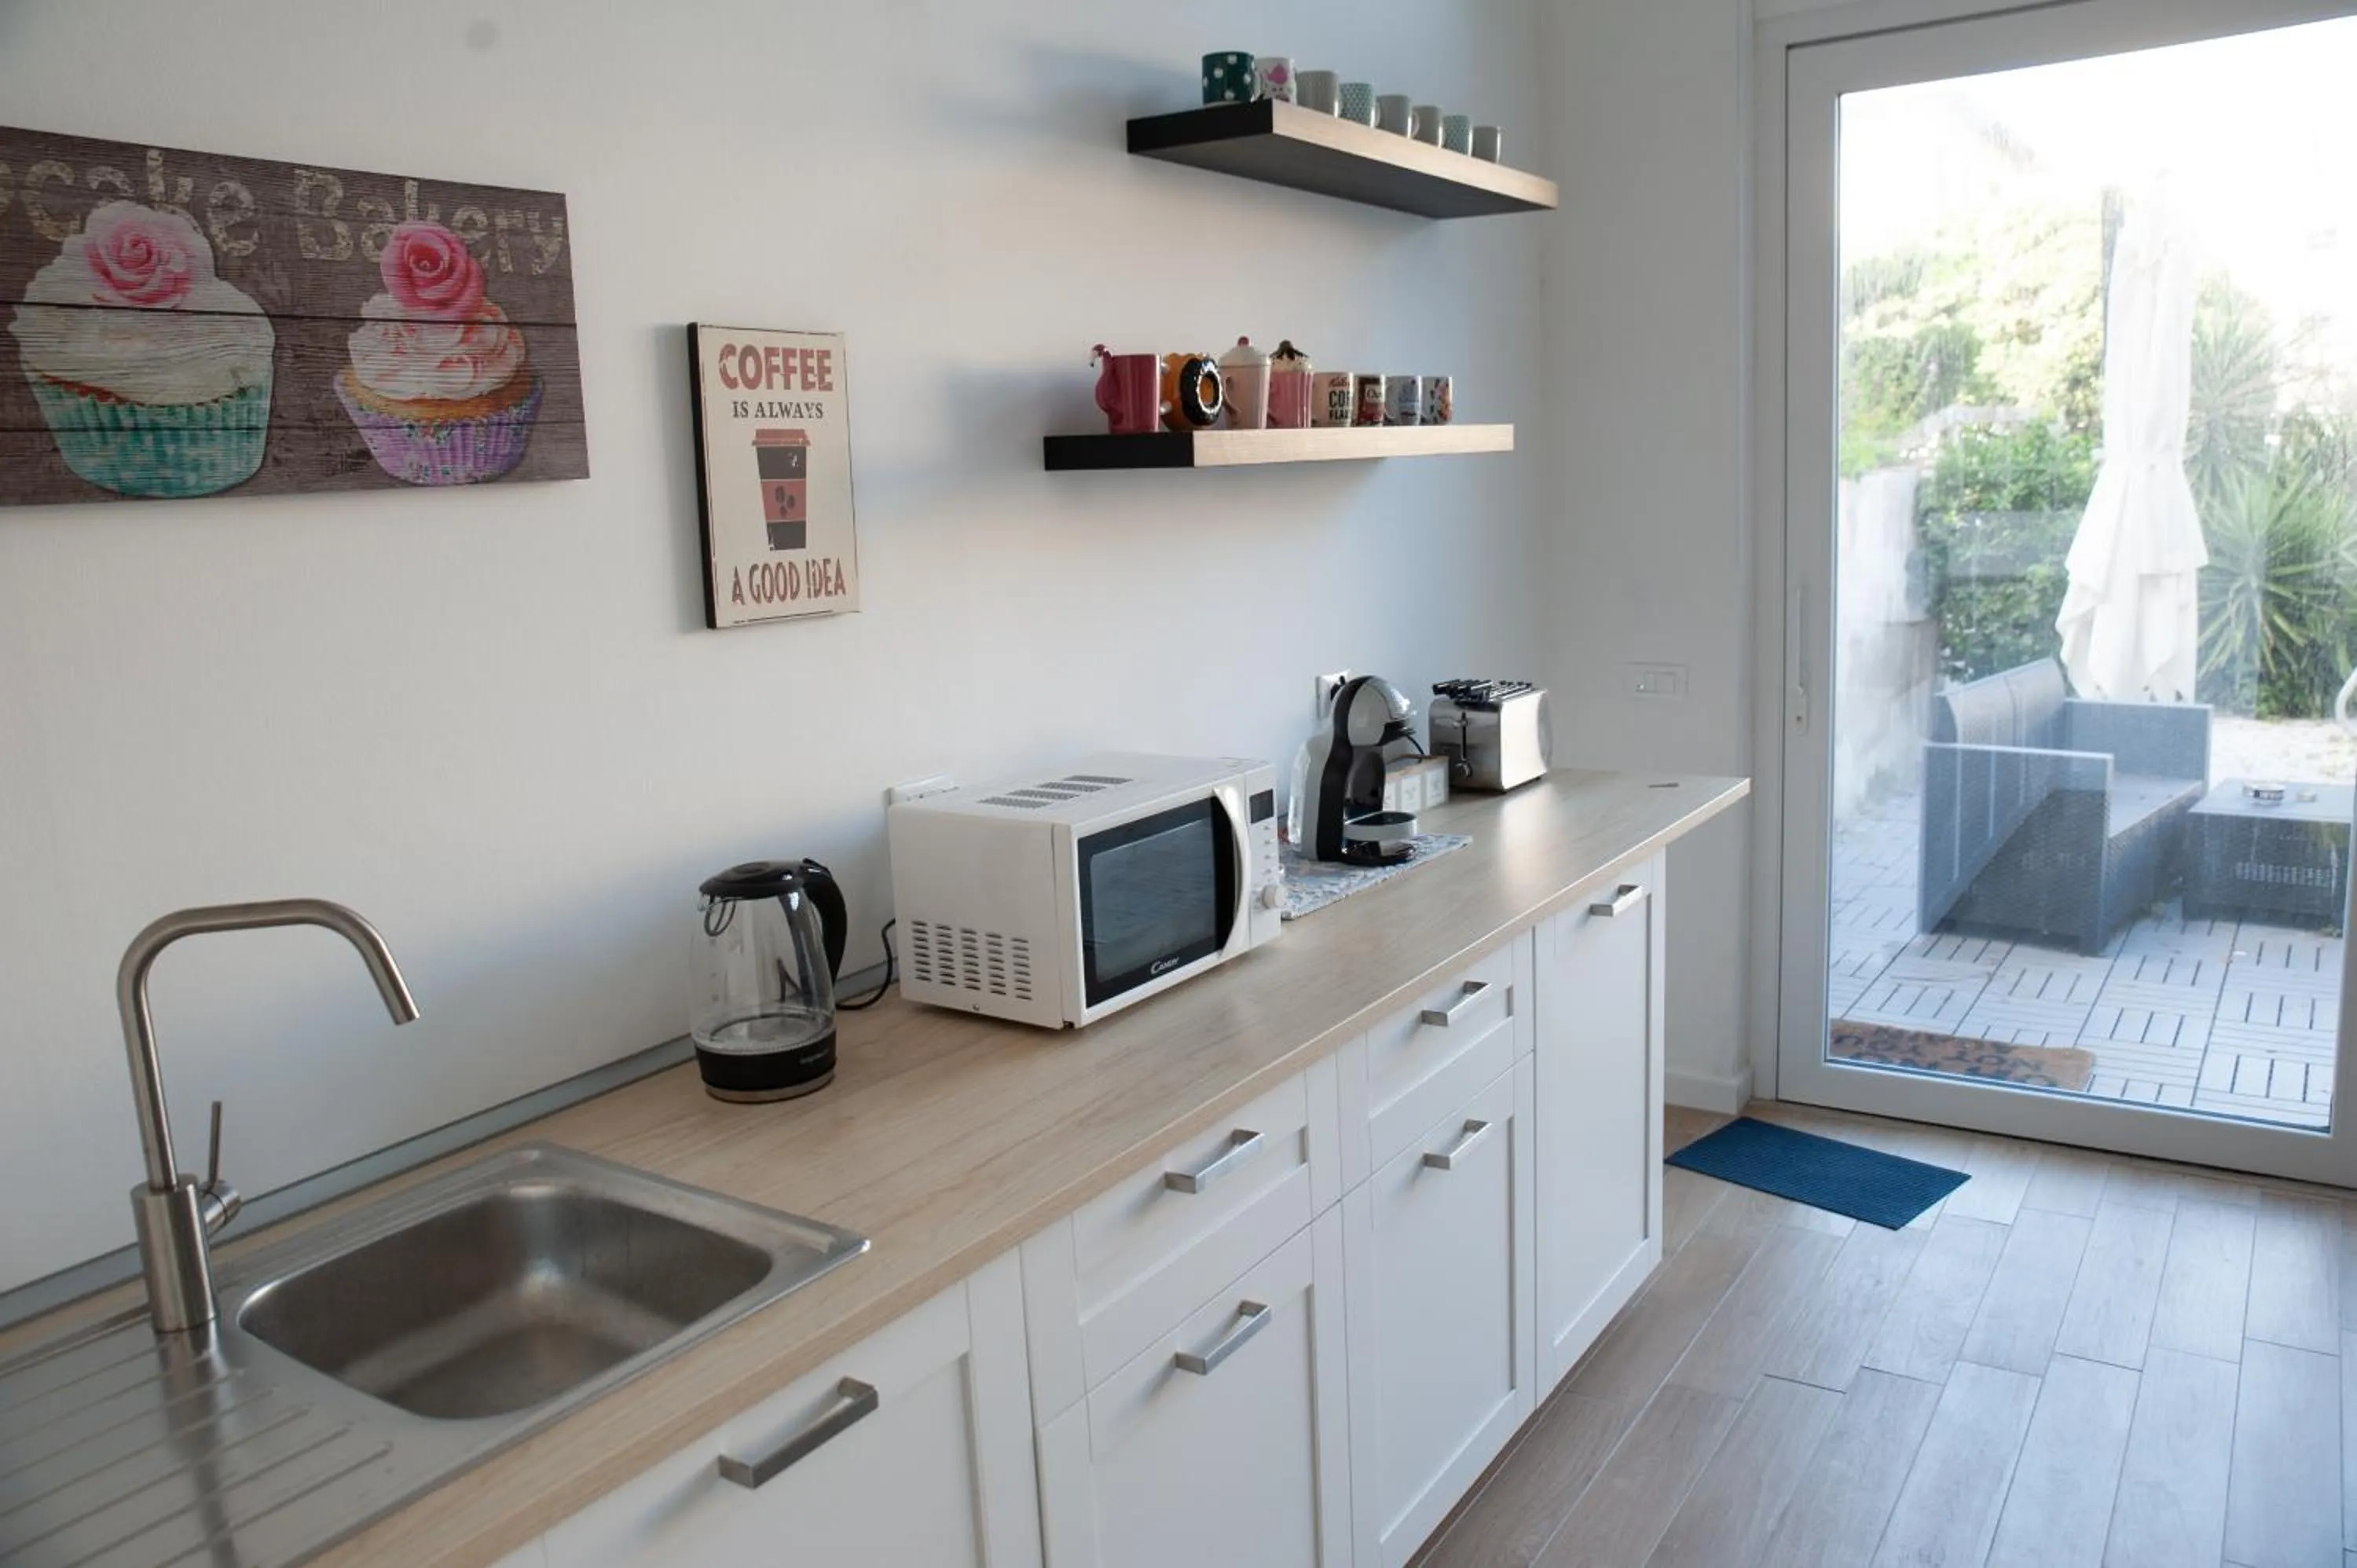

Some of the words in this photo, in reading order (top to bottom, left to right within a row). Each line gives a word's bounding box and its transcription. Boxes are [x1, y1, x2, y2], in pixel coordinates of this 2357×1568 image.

[0, 148, 259, 258] cke
[718, 343, 834, 392] COFFEE
[732, 401, 749, 419] IS
[755, 401, 823, 419] ALWAYS
[731, 566, 746, 606] A
[749, 560, 801, 604] GOOD
[805, 557, 846, 599] IDEA
